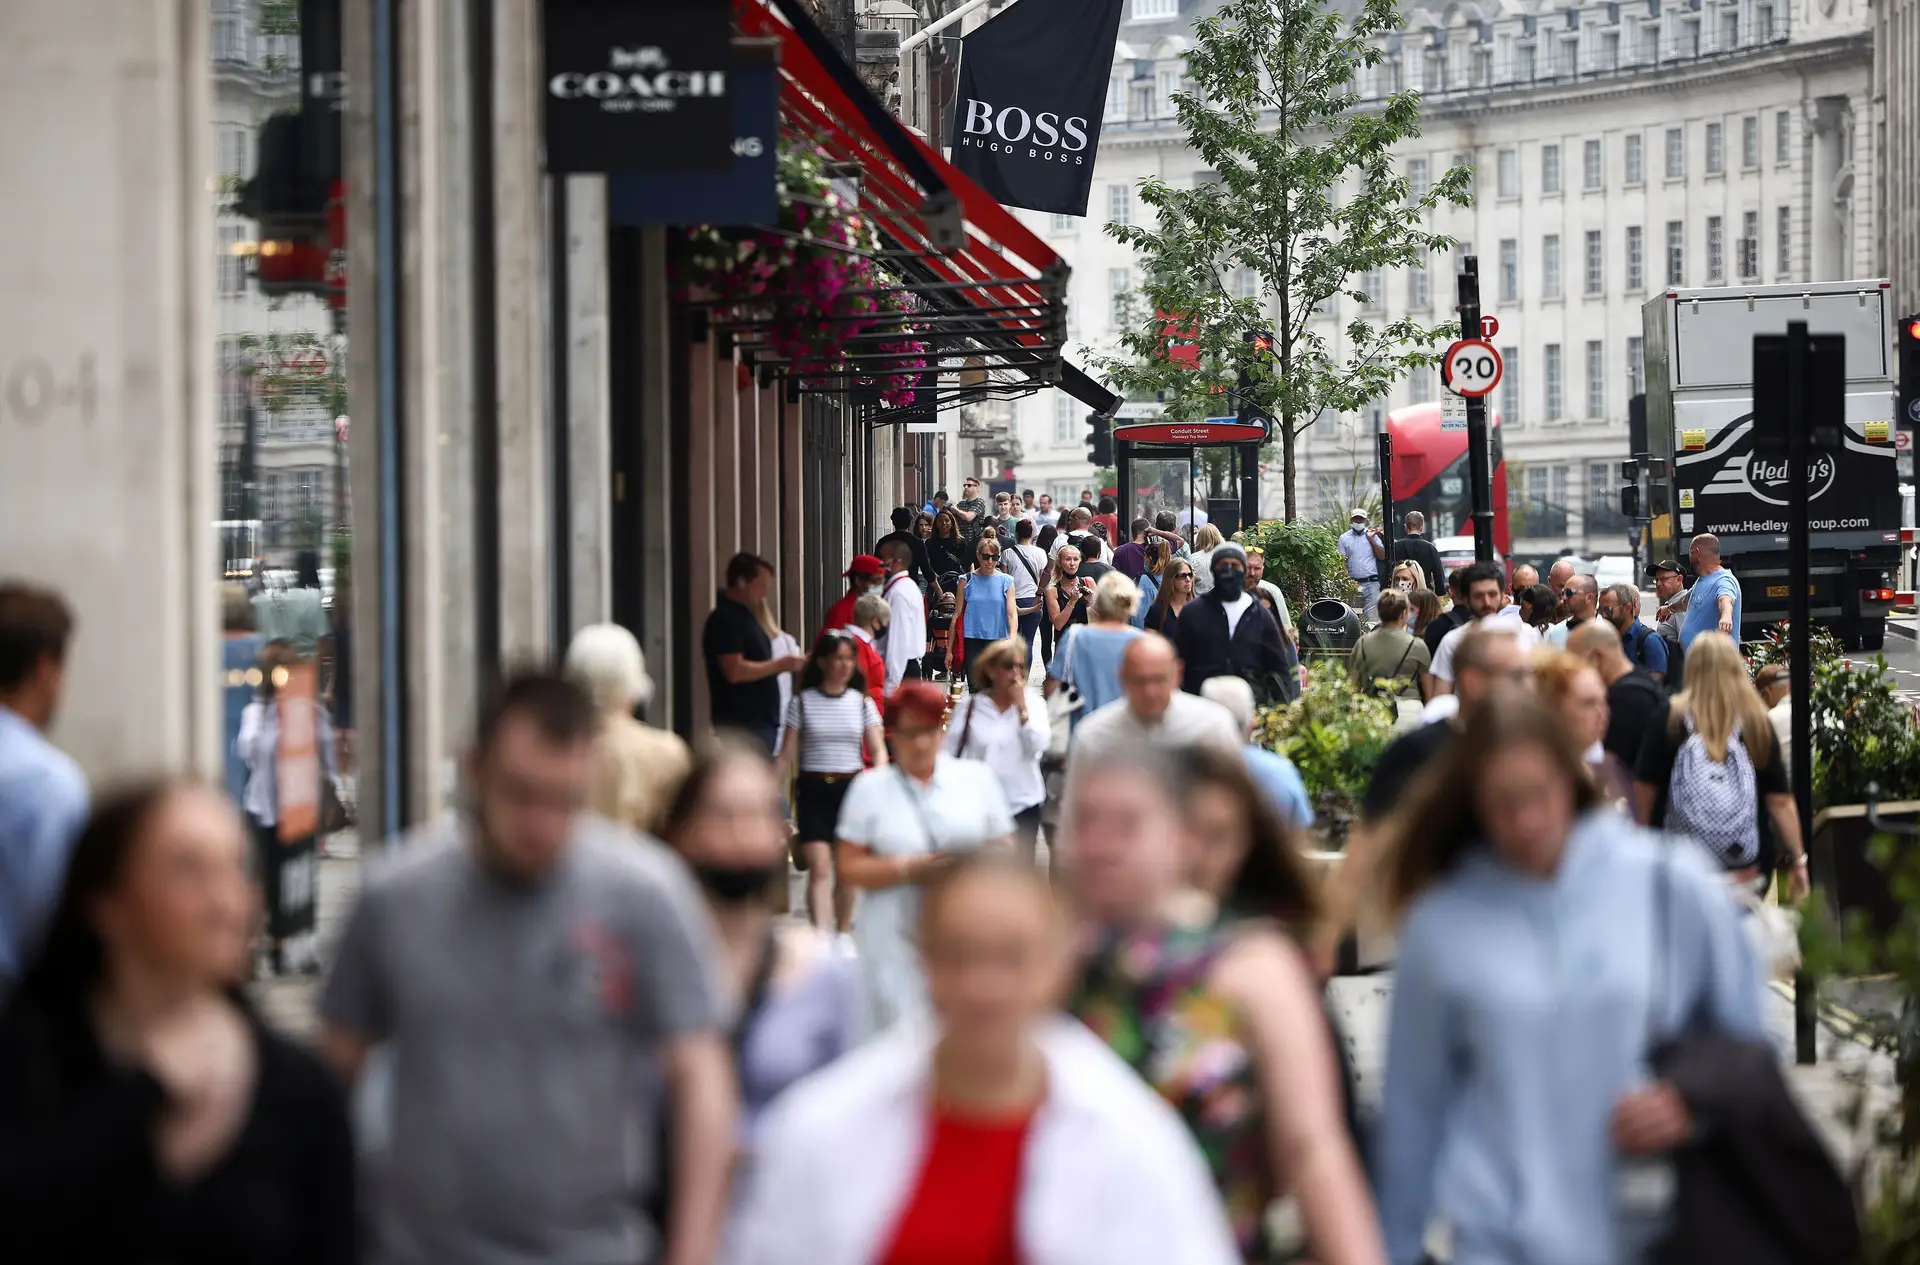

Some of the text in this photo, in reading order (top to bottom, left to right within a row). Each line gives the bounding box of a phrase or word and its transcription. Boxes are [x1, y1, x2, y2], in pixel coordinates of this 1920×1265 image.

[550, 71, 727, 98] COACH
[963, 98, 1088, 151] BOSS
[962, 137, 1083, 165] HUGO BOSS
[1482, 319, 1495, 336] T
[1456, 356, 1495, 380] 20
[979, 456, 1000, 479] B
[1751, 459, 1829, 483] Hedy's
[1707, 517, 1870, 533] www.Hedleyroup.com
